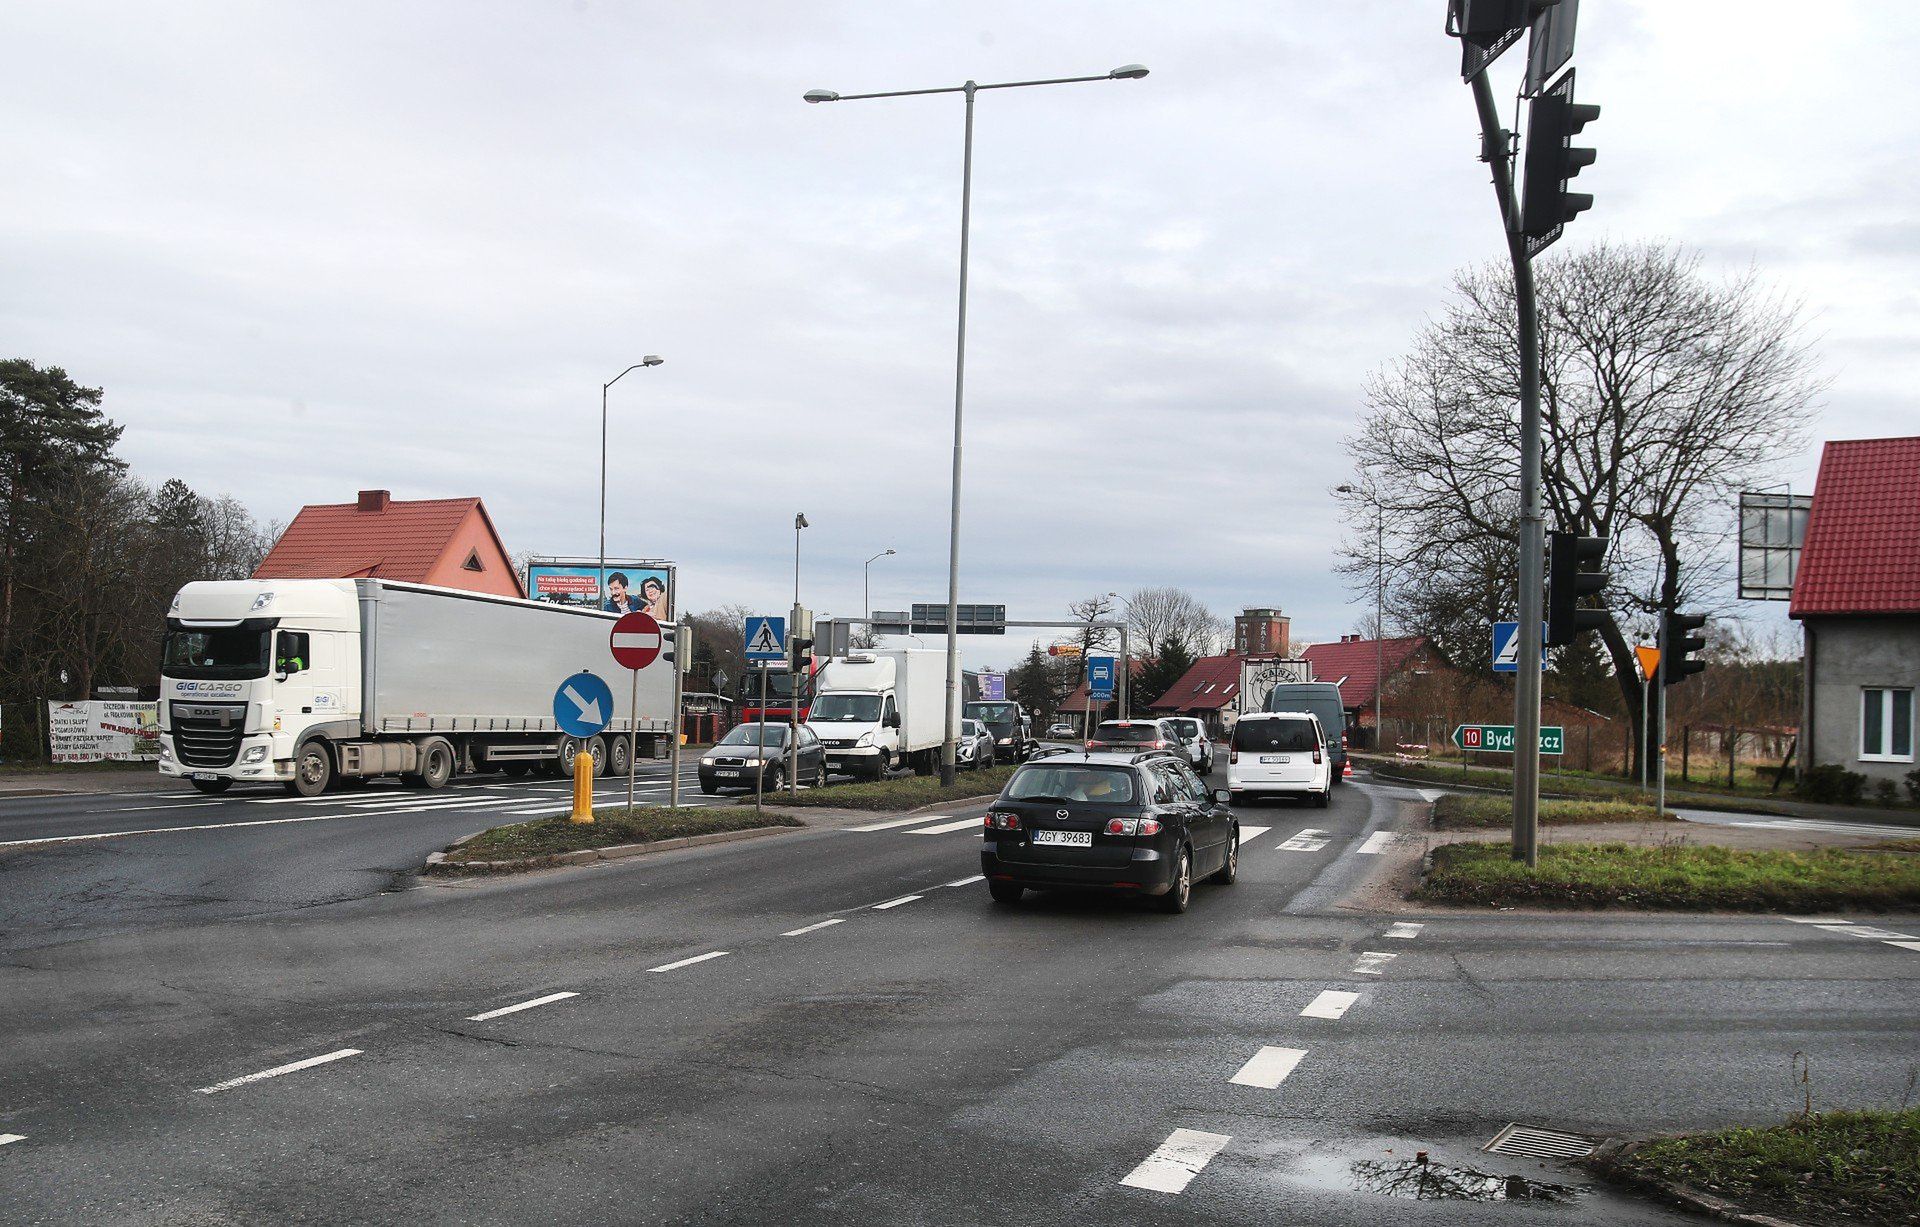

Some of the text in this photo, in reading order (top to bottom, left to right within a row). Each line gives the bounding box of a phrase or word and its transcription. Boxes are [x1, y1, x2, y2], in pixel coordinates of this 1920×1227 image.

[1256, 669, 1296, 684] SCANIA
[194, 708, 221, 716] DAF
[1466, 731, 1478, 744] 10
[1039, 831, 1091, 844] ZGY 39683
